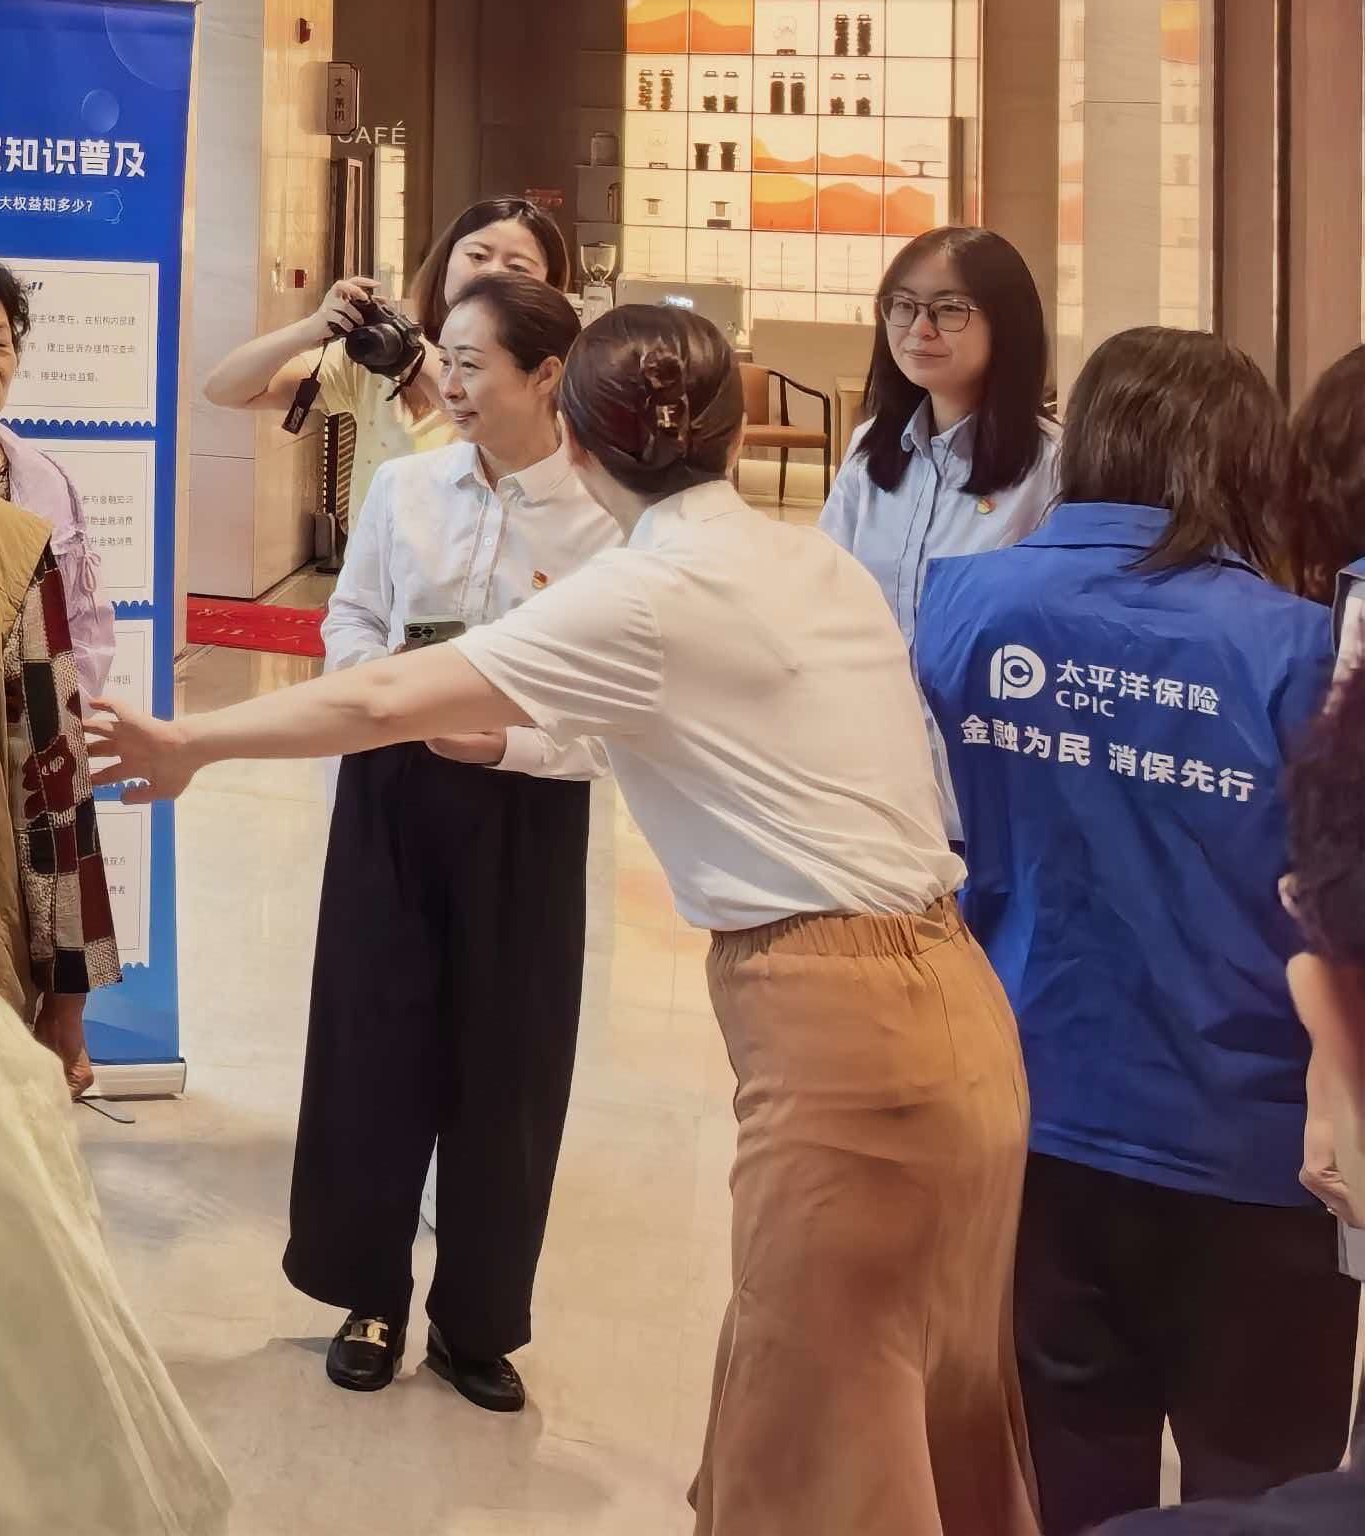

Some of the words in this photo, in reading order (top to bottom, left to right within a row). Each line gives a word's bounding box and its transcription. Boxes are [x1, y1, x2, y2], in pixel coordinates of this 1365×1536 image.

[1055, 690, 1115, 718] CPIC
[1056, 660, 1219, 715] 太平洋保险
[960, 714, 1091, 767] 金融为民
[1108, 742, 1255, 802] 消保先行
